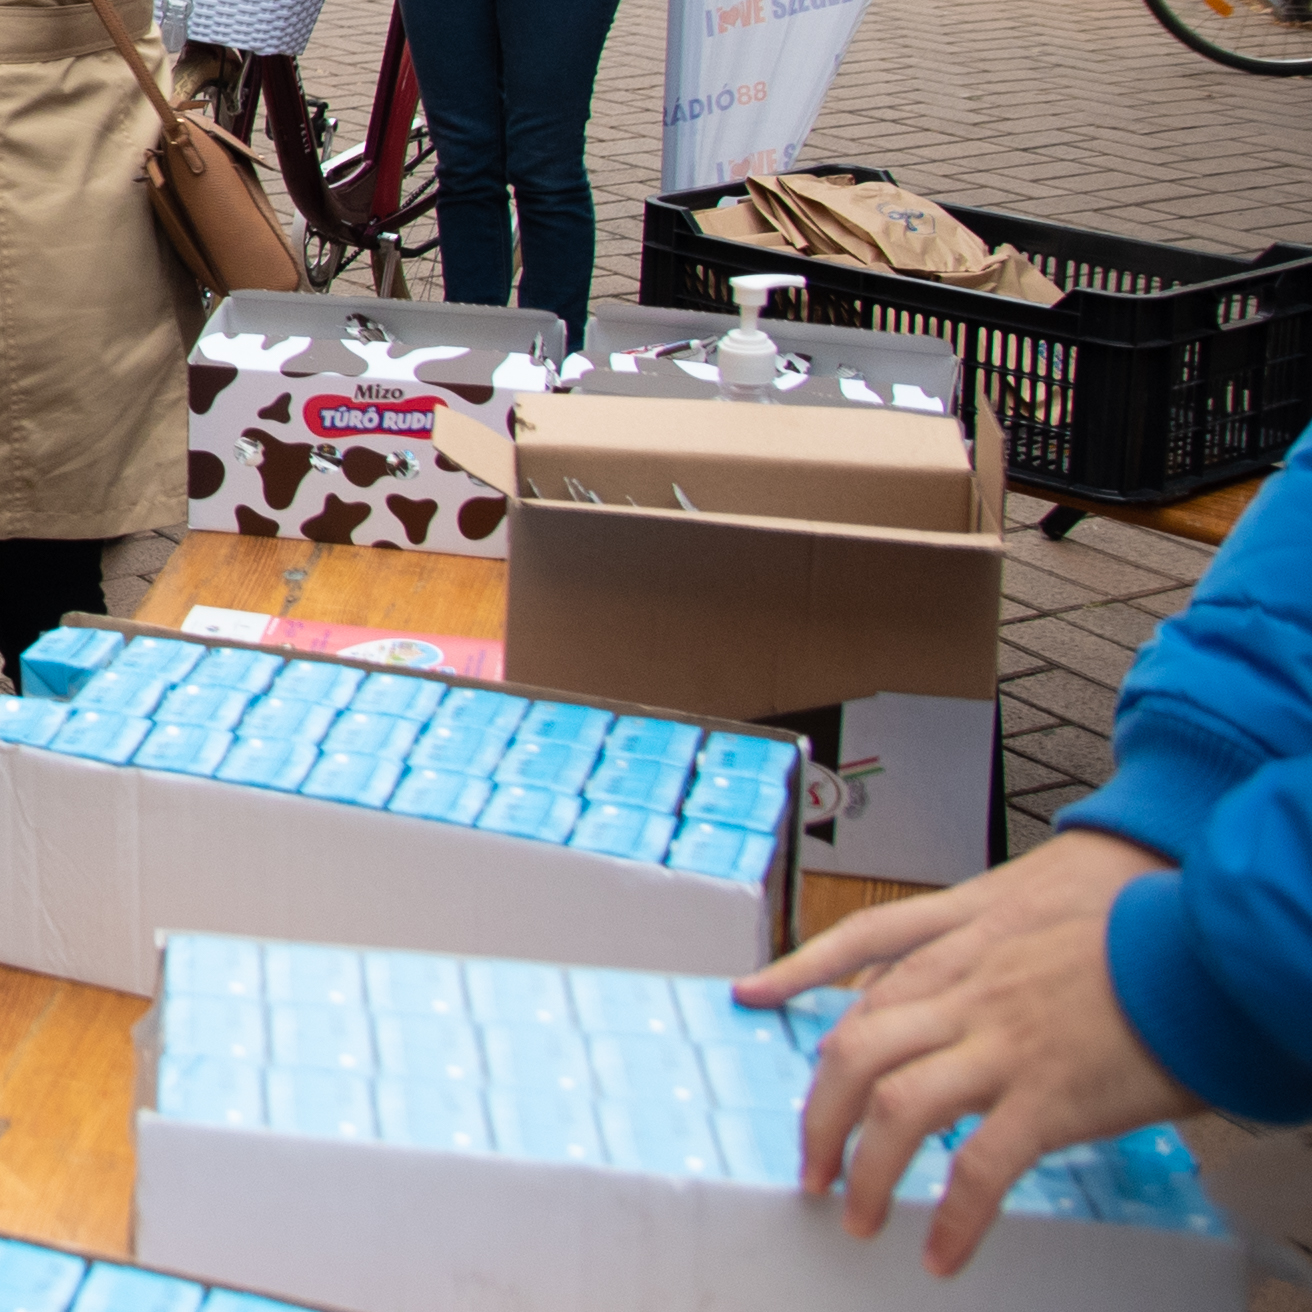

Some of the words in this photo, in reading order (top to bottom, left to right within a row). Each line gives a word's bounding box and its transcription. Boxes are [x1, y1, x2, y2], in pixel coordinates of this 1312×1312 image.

[705, 9, 715, 37] I
[354, 383, 405, 401] Mizo
[320, 405, 381, 430] TÚRÓ
[382, 410, 434, 432] RUDI
